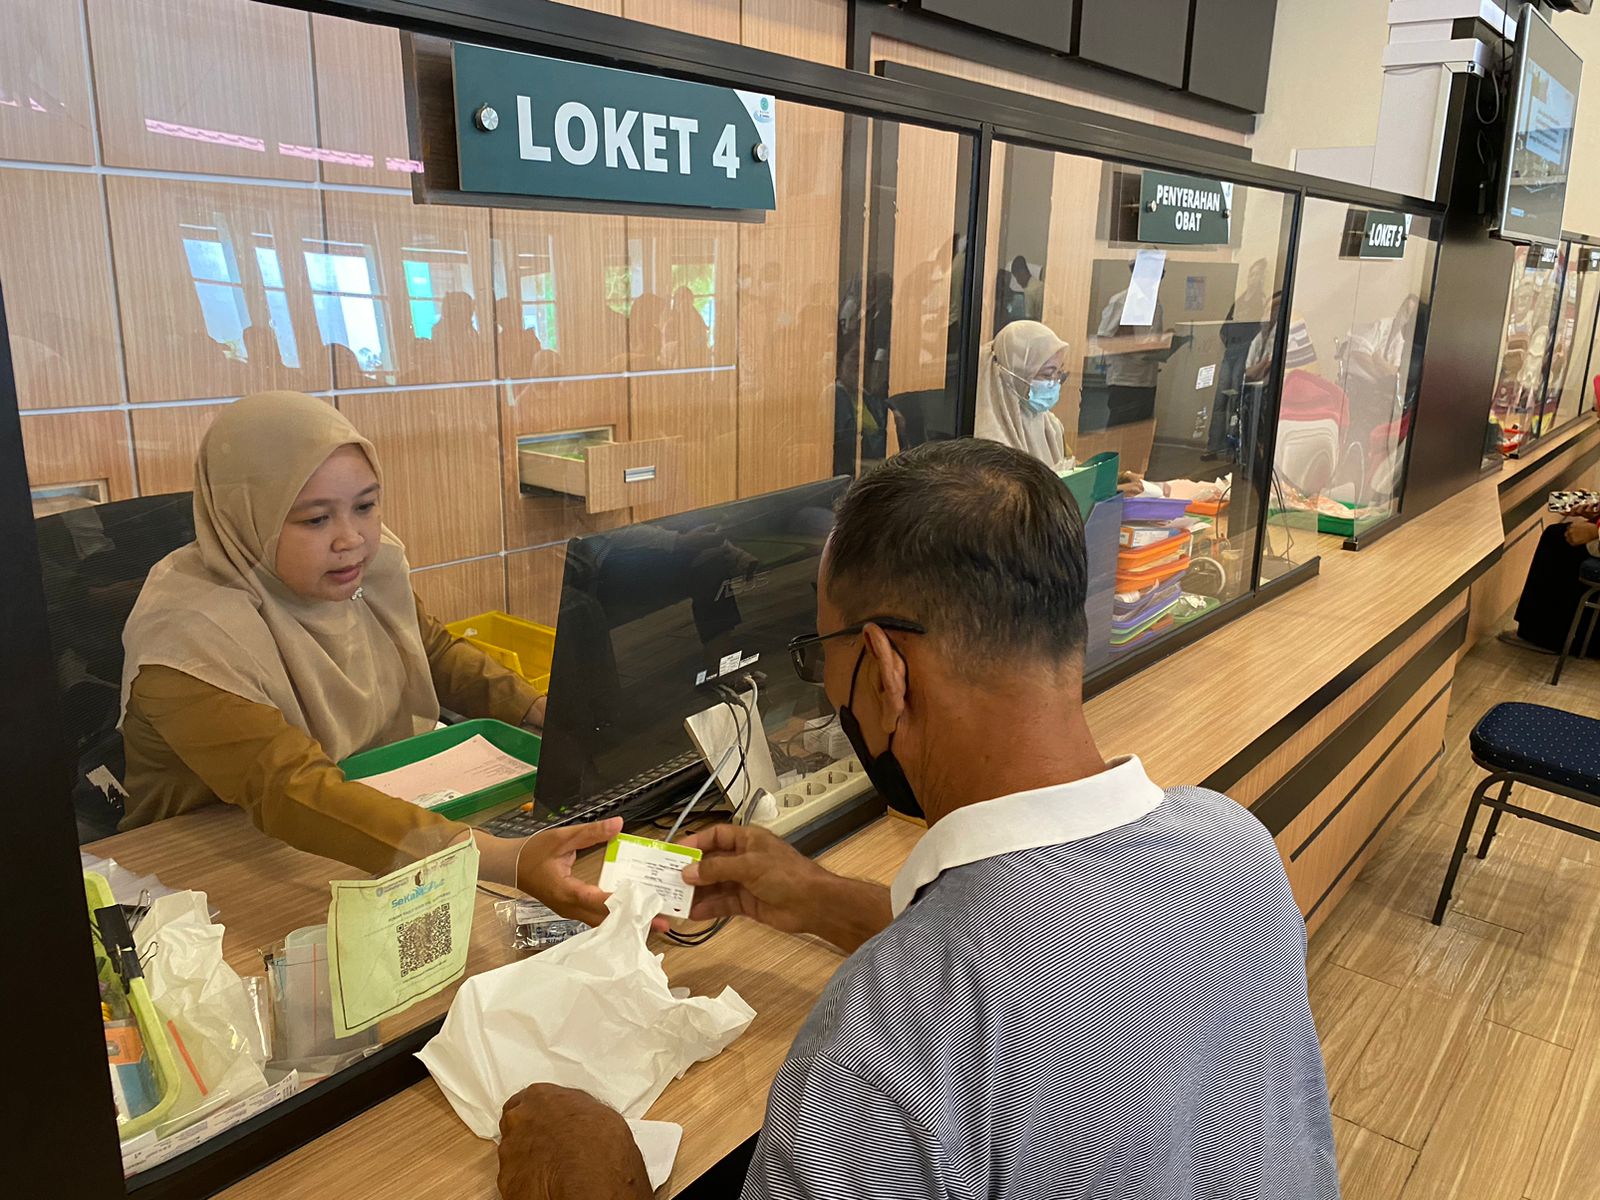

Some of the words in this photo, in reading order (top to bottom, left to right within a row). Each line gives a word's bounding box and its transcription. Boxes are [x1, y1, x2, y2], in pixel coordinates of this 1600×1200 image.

[516, 95, 698, 175] LOKET
[712, 124, 740, 179] 4
[1156, 184, 1220, 212] PENYERAHAN
[1175, 210, 1202, 231] OBAT
[1369, 223, 1398, 247] LOKET
[1394, 225, 1403, 248] 3
